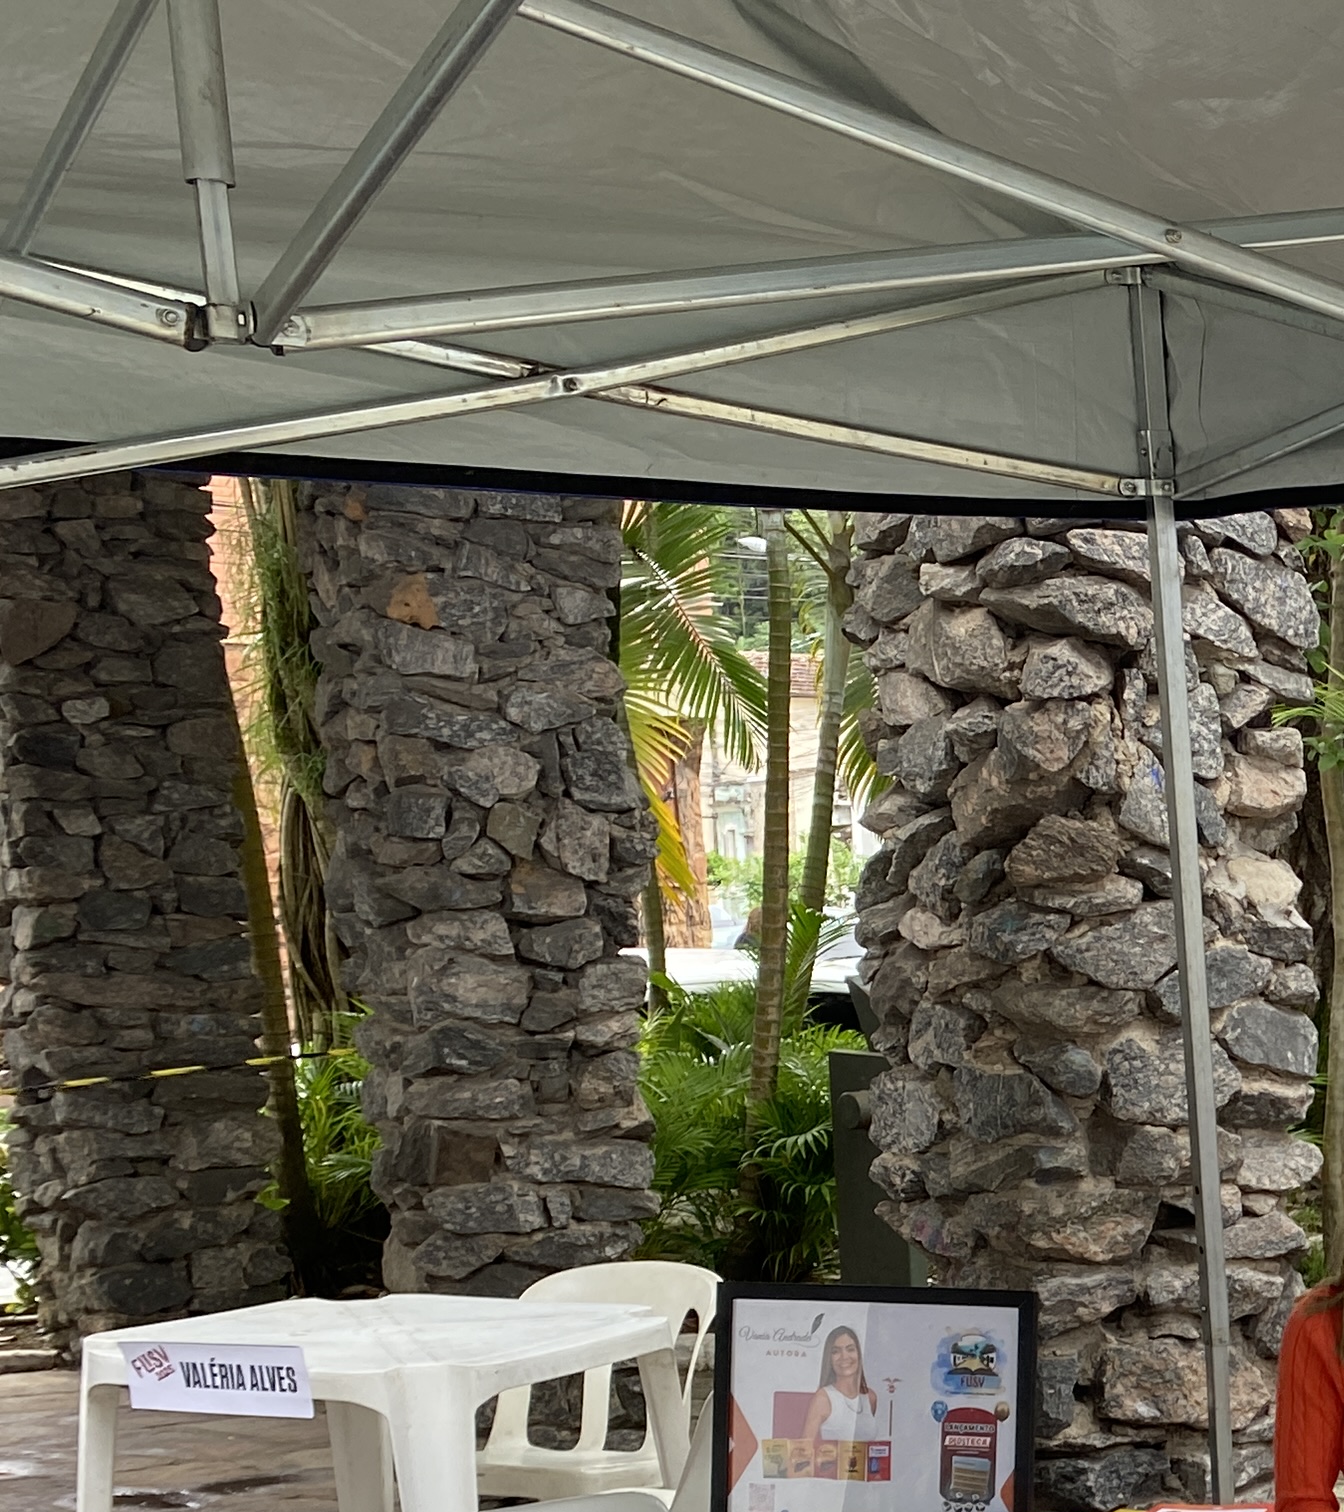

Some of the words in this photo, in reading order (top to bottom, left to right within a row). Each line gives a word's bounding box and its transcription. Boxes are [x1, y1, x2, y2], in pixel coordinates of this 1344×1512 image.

[765, 1349, 807, 1357] AUTORA
[179, 1357, 247, 1391] VALÉRIA
[249, 1364, 298, 1393] ALVES
